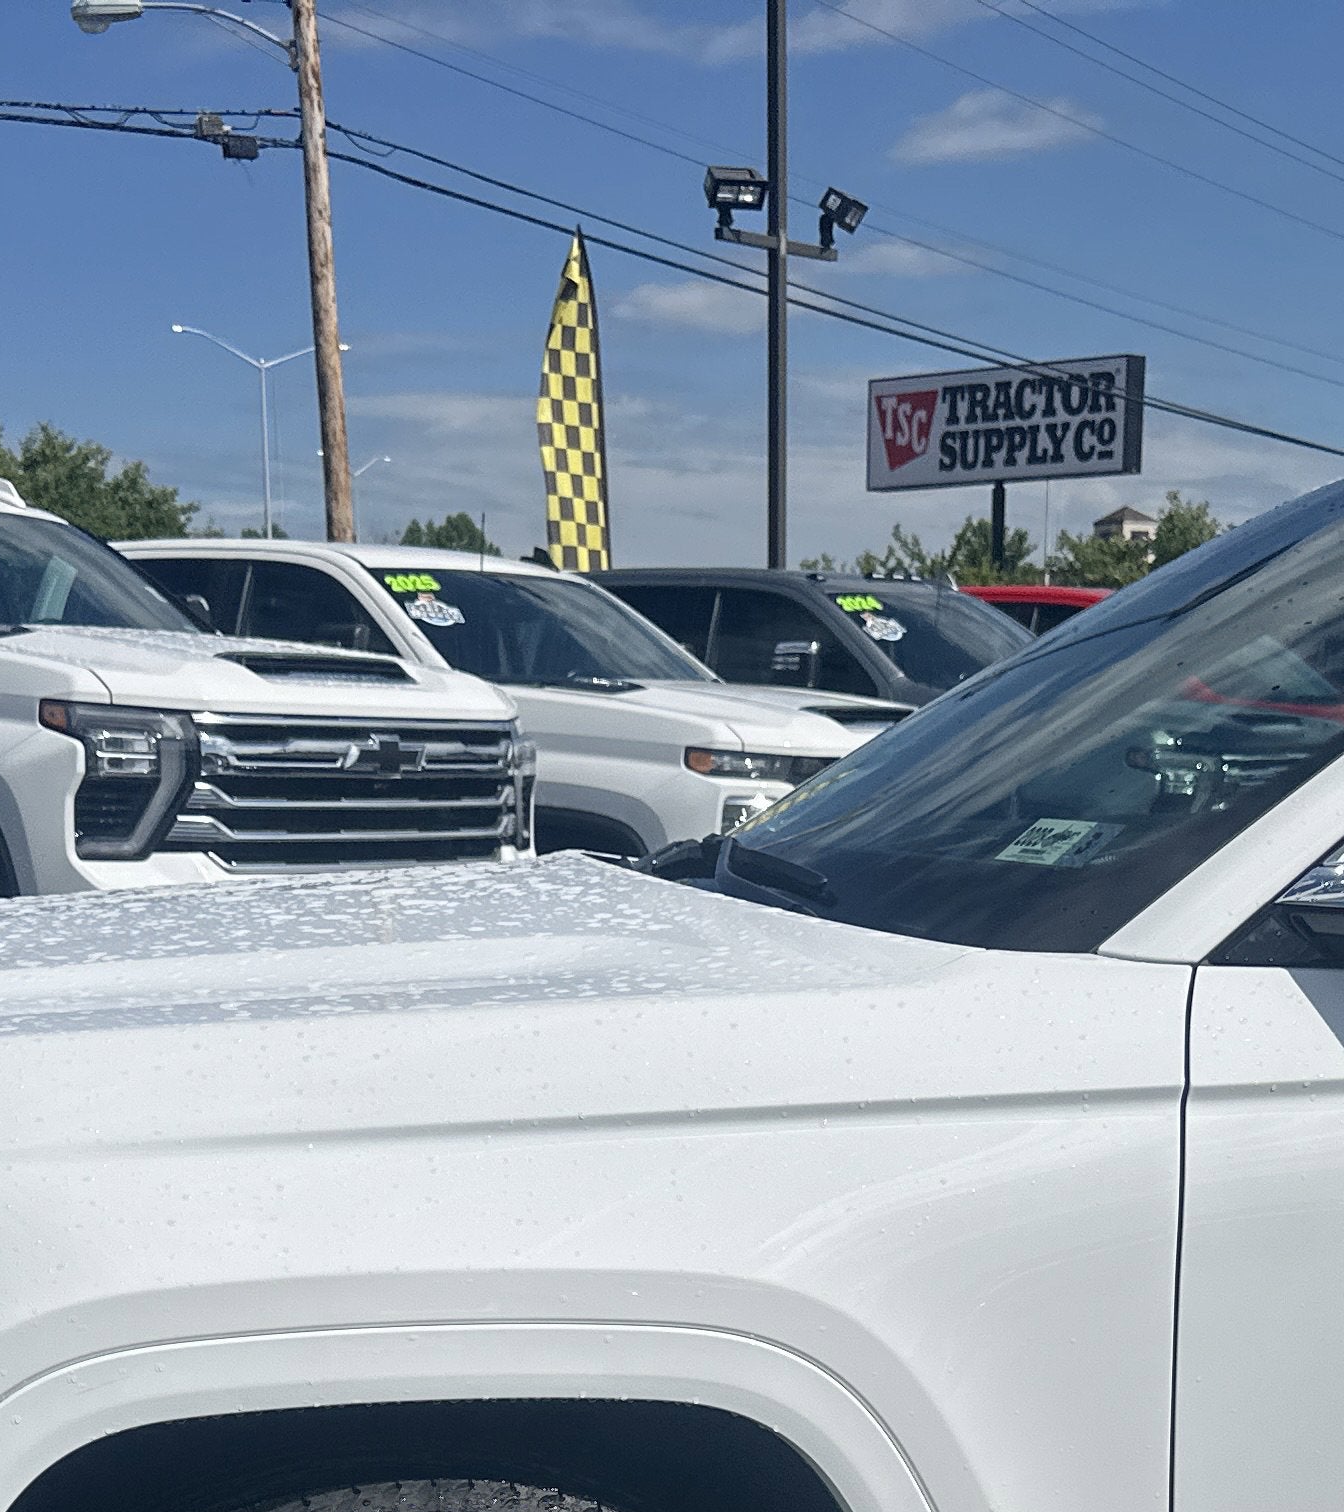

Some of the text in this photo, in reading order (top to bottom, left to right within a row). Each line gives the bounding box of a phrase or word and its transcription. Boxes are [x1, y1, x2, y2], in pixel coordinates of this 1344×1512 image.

[941, 371, 1117, 426] TRACTOR
[880, 396, 928, 455] TSC
[938, 420, 1071, 472] SUPPLY
[384, 574, 441, 592] 2025
[836, 594, 884, 612] 2024
